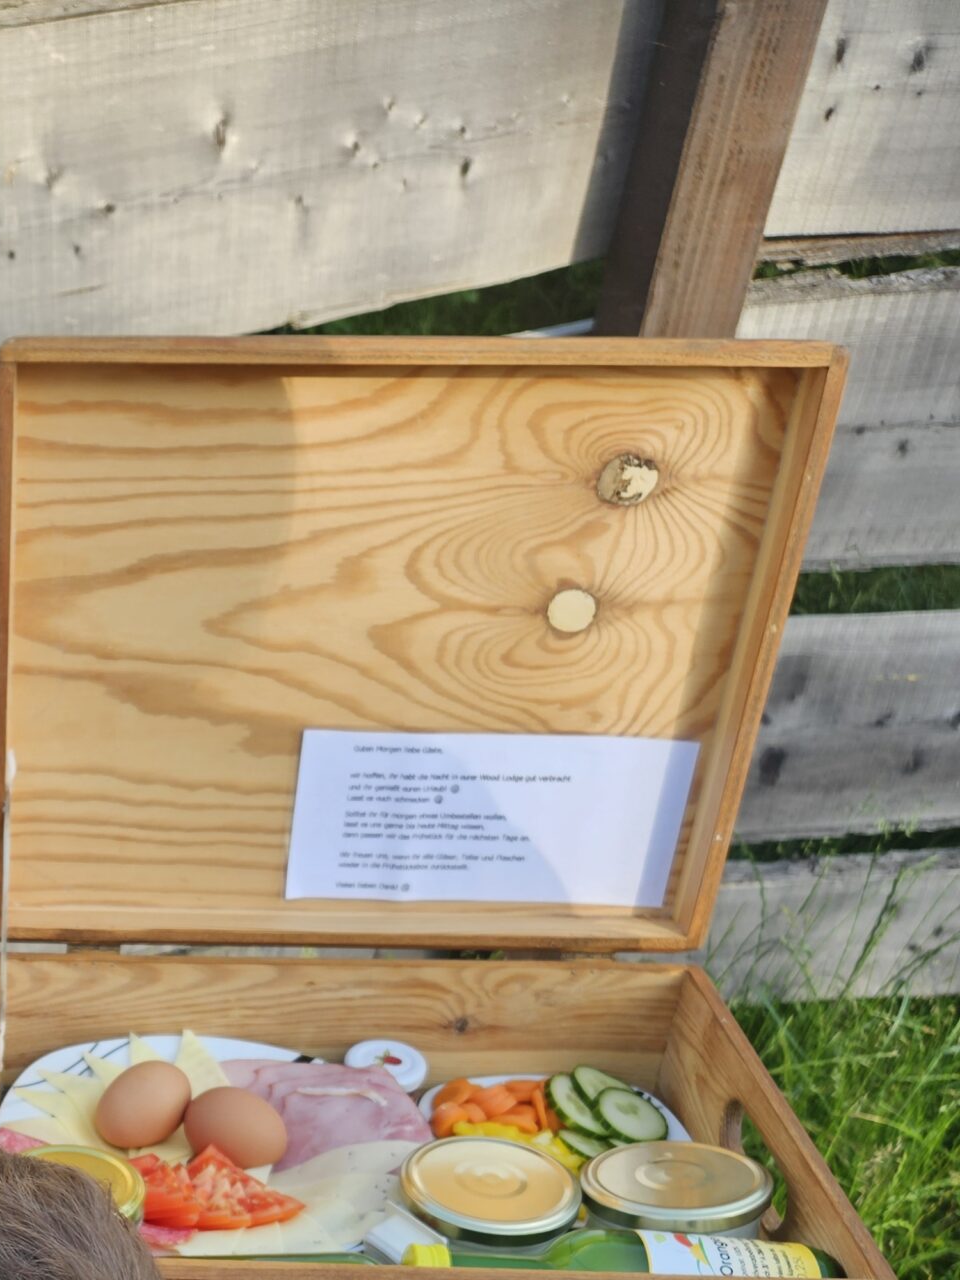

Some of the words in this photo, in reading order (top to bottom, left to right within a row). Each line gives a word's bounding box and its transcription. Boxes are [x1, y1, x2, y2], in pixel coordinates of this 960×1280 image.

[353, 745, 373, 754] Guten
[376, 745, 402, 755] Morgen
[400, 772, 416, 780] habt
[479, 773, 501, 781] Wood
[502, 774, 523, 783] Lodge
[525, 775, 537, 783] gut
[502, 834, 519, 842] Tage
